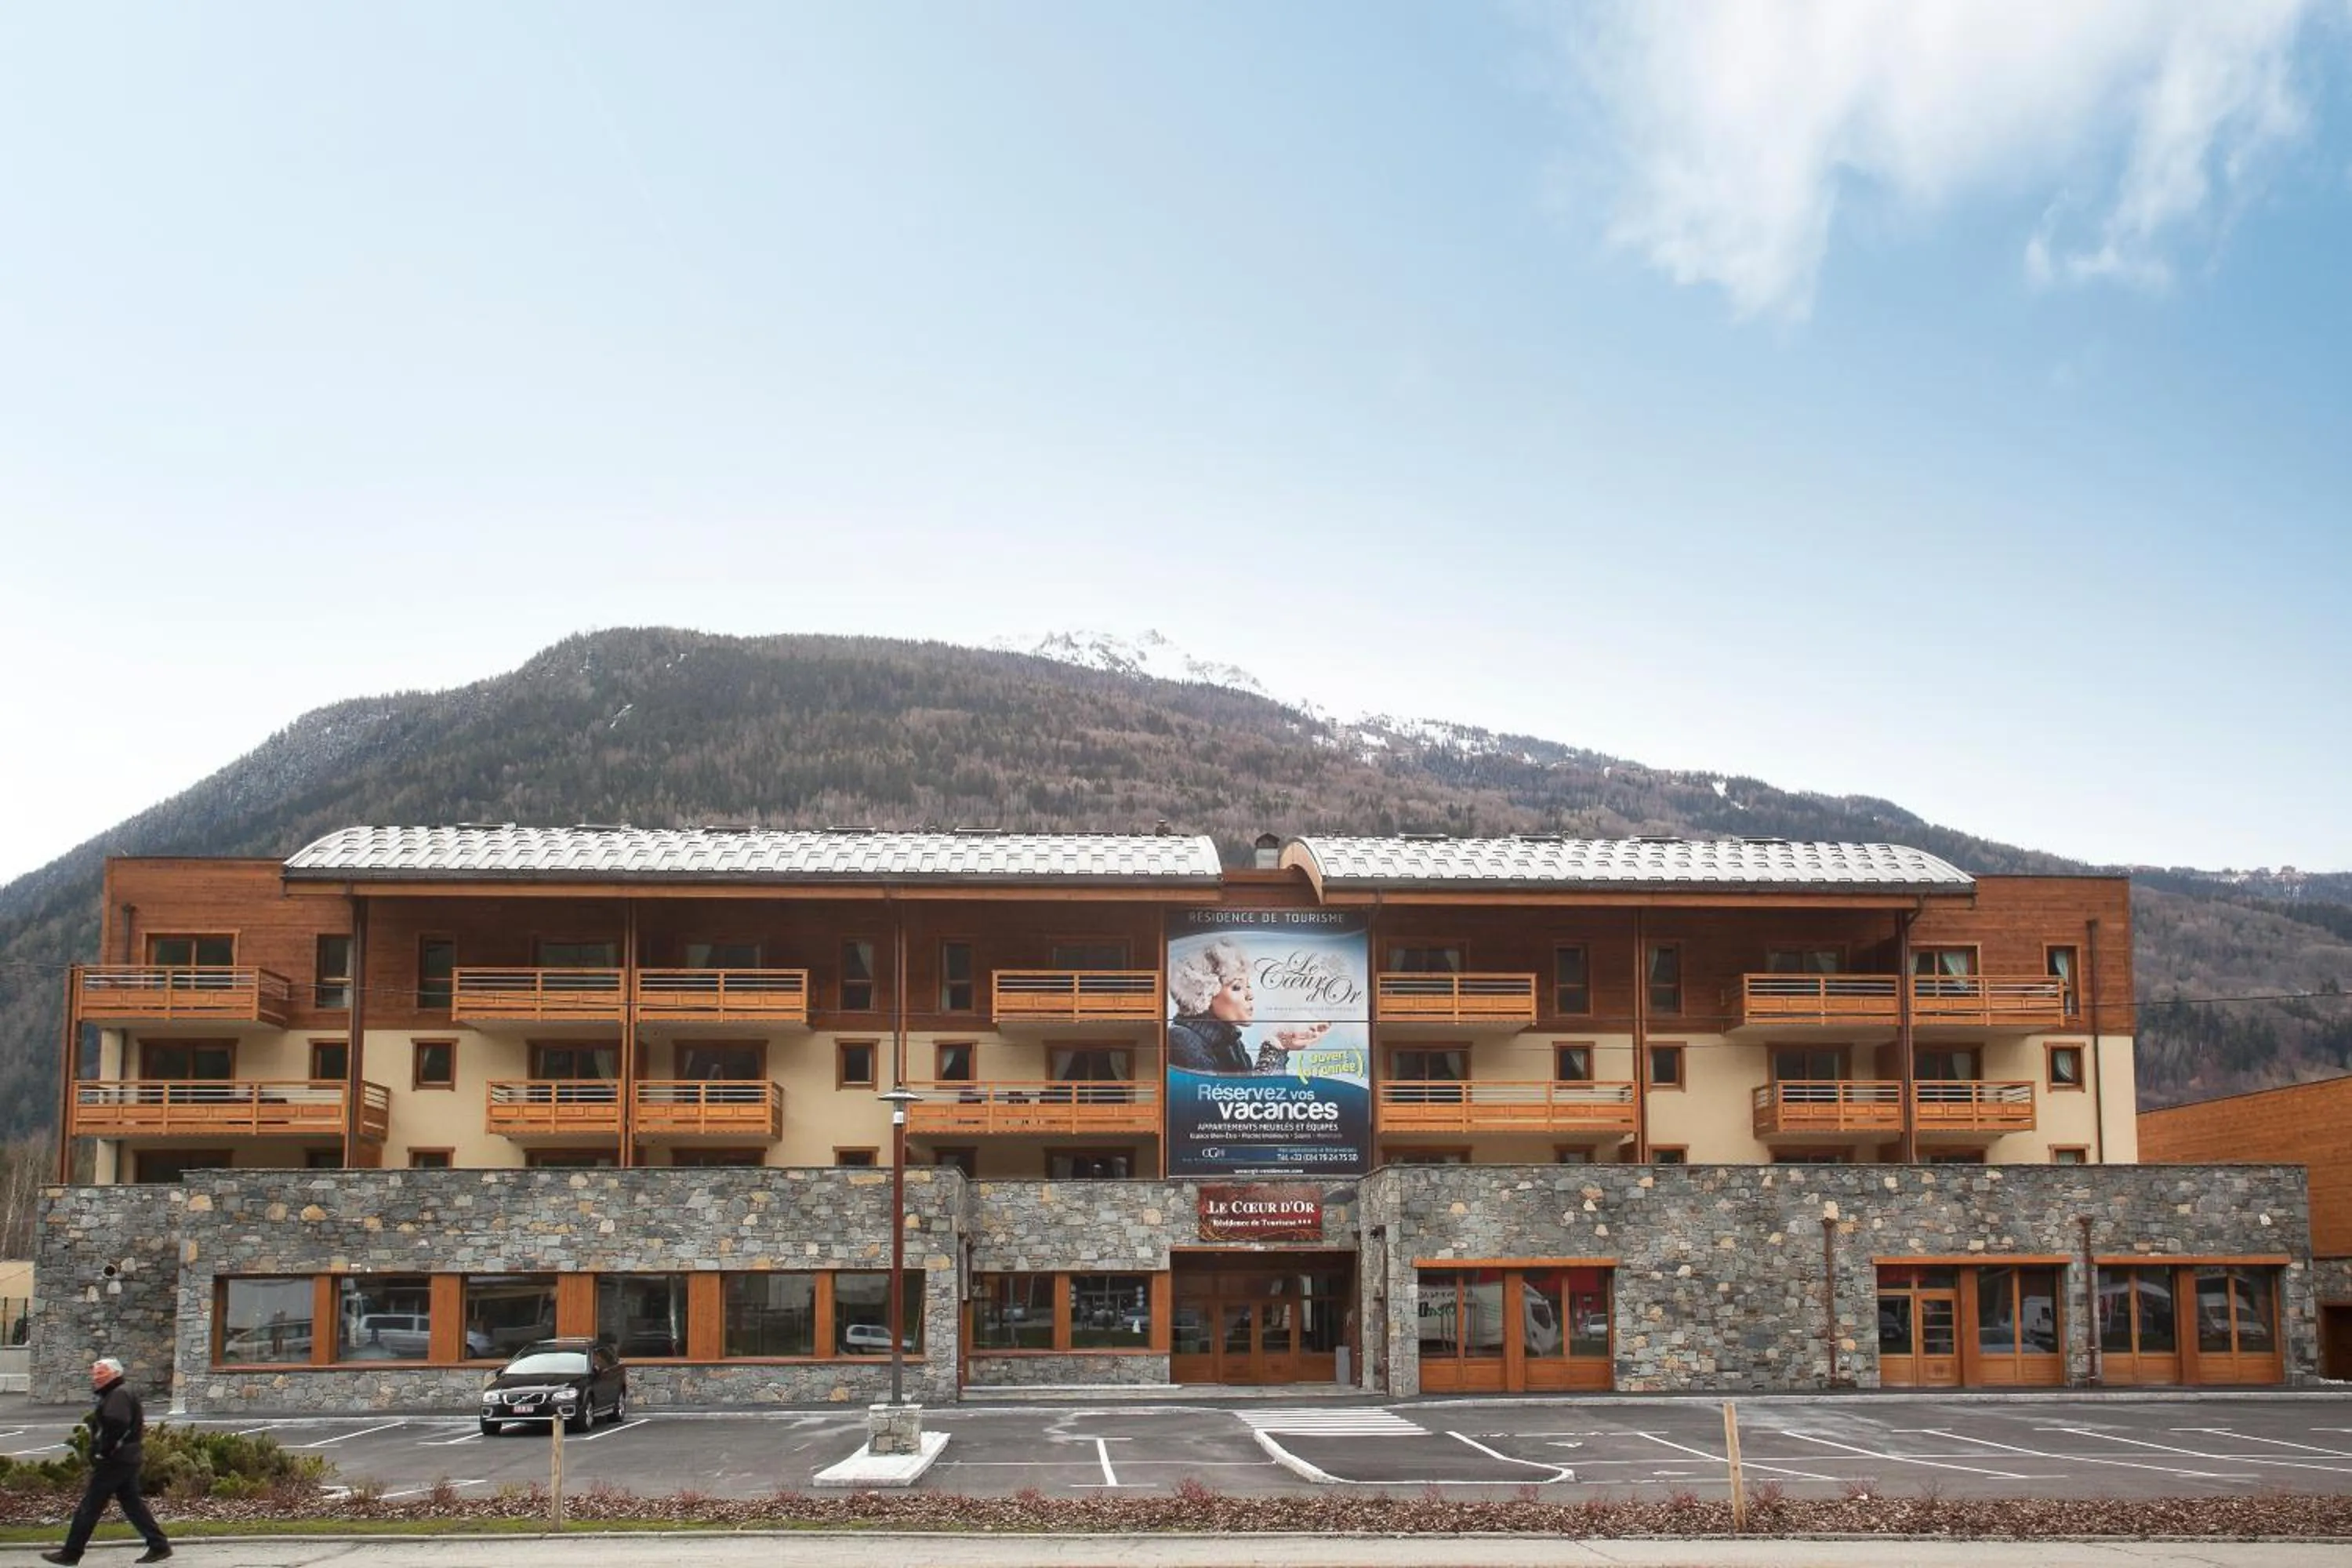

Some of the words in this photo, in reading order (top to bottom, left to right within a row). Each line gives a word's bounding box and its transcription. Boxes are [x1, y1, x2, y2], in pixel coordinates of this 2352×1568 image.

[1261, 912, 1277, 923] DE
[1285, 912, 1344, 923] TOURISME
[1197, 1083, 1287, 1101] Réservez
[1290, 1091, 1315, 1100] vos
[1218, 1102, 1339, 1120] vacances
[1207, 1200, 1228, 1214] LE
[1231, 1200, 1276, 1213] CŒUR
[1280, 1200, 1315, 1213] D'OR
